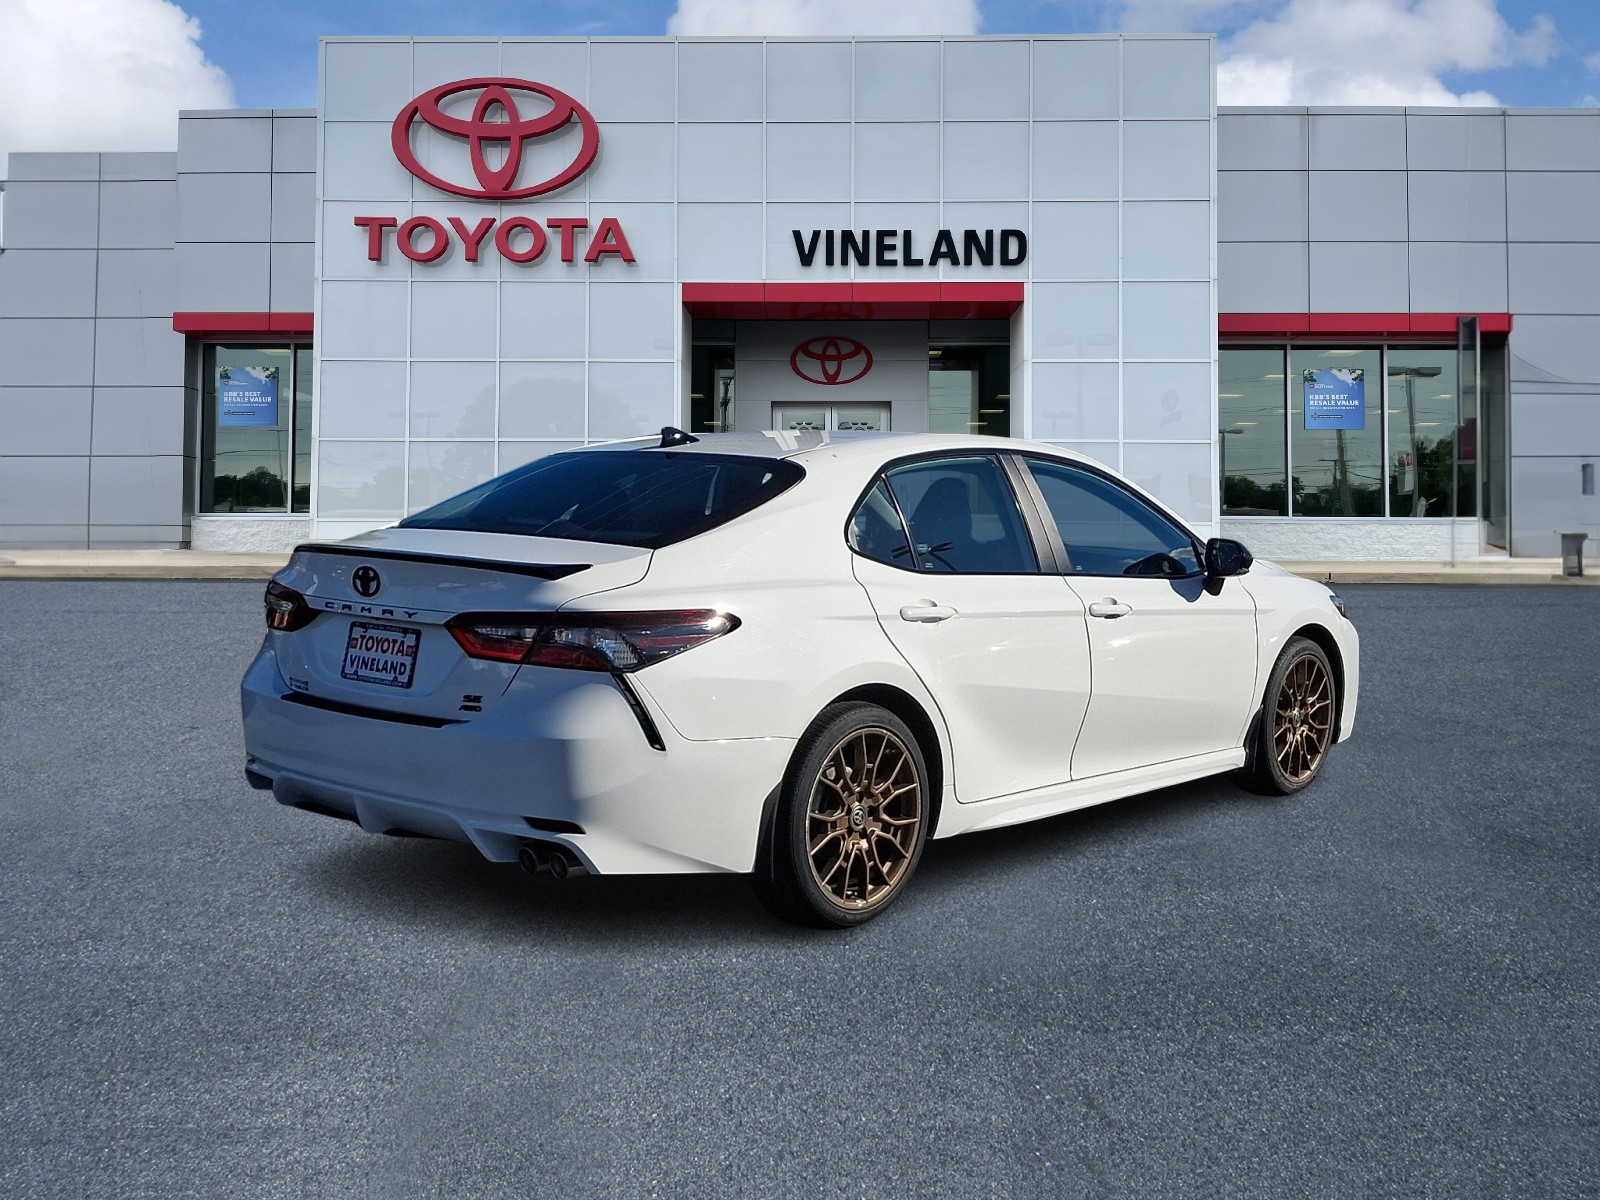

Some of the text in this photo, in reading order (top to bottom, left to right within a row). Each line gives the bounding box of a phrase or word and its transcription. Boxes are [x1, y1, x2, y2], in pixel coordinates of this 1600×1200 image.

[354, 216, 637, 263] TOYOTA
[792, 229, 1028, 266] VINELAND
[324, 601, 419, 619] CAMRY
[358, 634, 406, 657] TOYOTA
[349, 654, 407, 676] VINELAND
